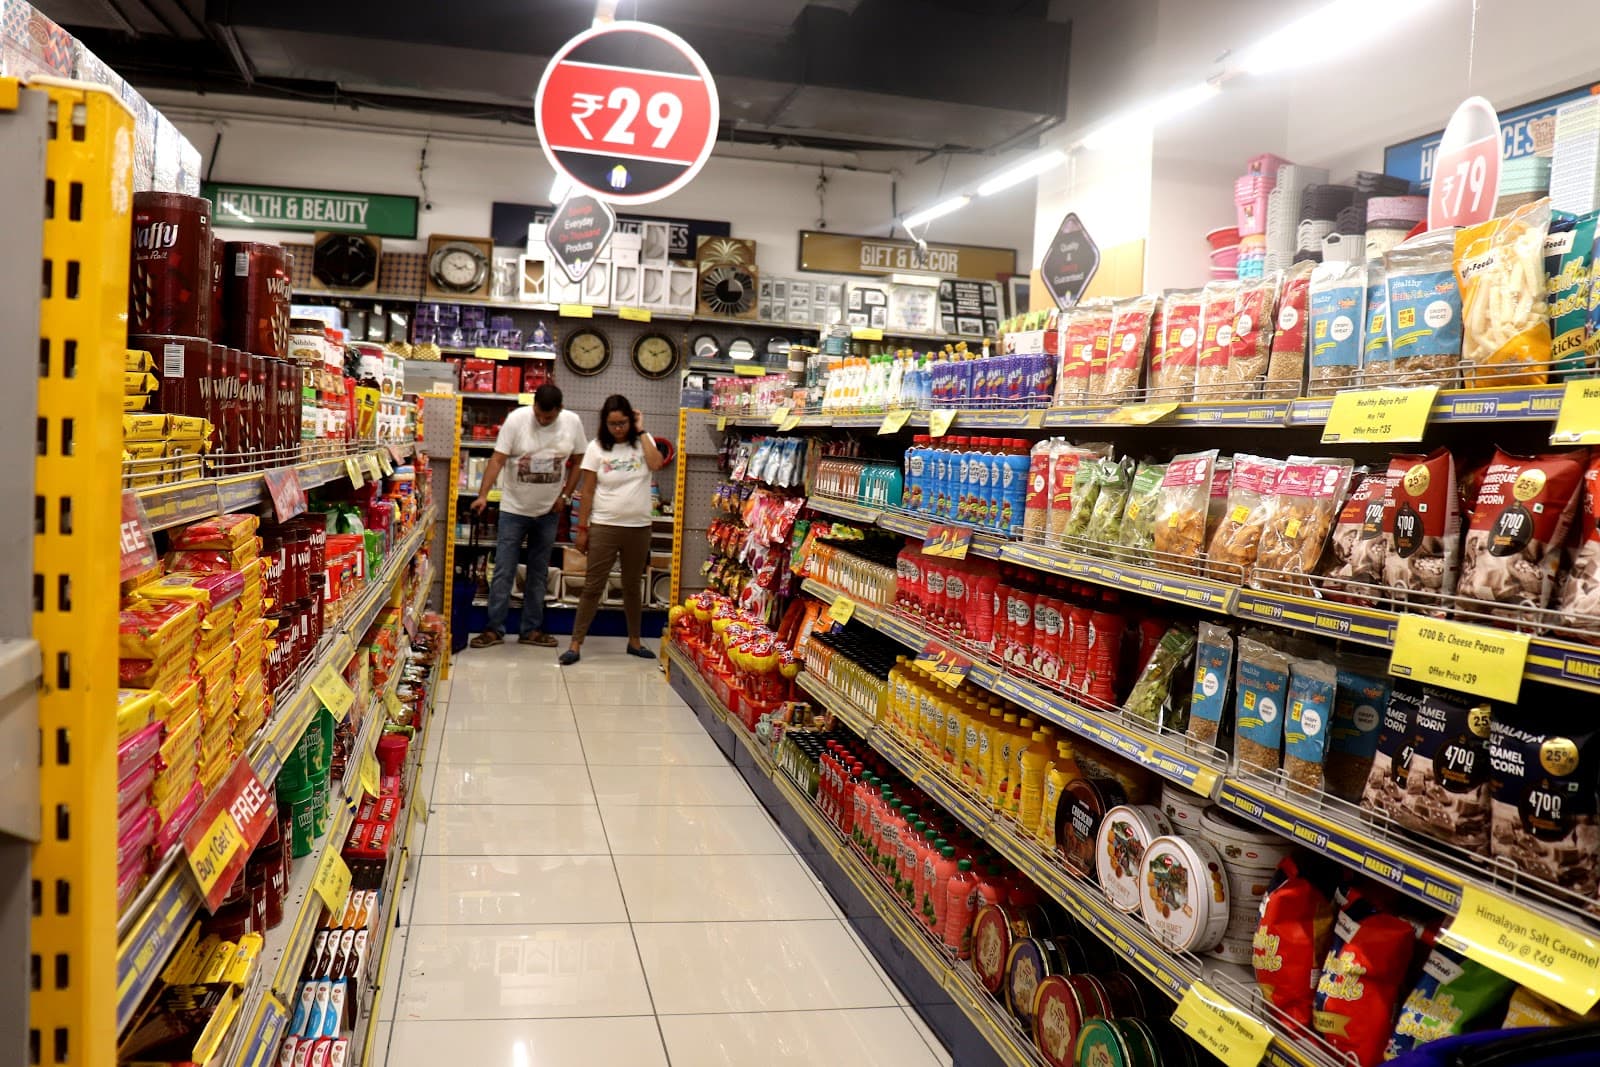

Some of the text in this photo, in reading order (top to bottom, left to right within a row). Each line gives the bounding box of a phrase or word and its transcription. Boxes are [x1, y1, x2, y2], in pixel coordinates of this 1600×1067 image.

[571, 87, 683, 149] ₹29
[1441, 155, 1487, 219] ₹79
[216, 192, 369, 224] HEALTH & BEAUTY
[564, 216, 595, 230] Everyday
[565, 242, 594, 254] Products
[861, 245, 958, 273] GIFT & DECOR
[1392, 279, 1422, 289] Healthy
[1552, 334, 1581, 356] ticks
[1356, 399, 1377, 407] Healthy
[1394, 396, 1408, 404] Puff
[1366, 425, 1378, 434] Price
[1500, 513, 1524, 536] 4700
[120, 520, 146, 554] EE
[1317, 613, 1350, 632] MARKET99
[1418, 628, 1505, 656] 4700 Bc Cheese Popcorn
[1451, 653, 1460, 663] At
[1428, 666, 1477, 685] Offer Price ₹39
[1445, 745, 1475, 770] 4700
[1545, 749, 1575, 764] 25%
[230, 777, 267, 832] FREE
[1235, 796, 1263, 818] MARKET99
[1529, 790, 1562, 818] 4700
[1295, 824, 1327, 847] MARKET99
[195, 858, 217, 882] Buy
[212, 830, 231, 856] Get
[1365, 857, 1401, 882] MARKET99
[1475, 904, 1600, 969] Himalayan Salt Caramel
[1497, 933, 1555, 967] Buy @ ₹49
